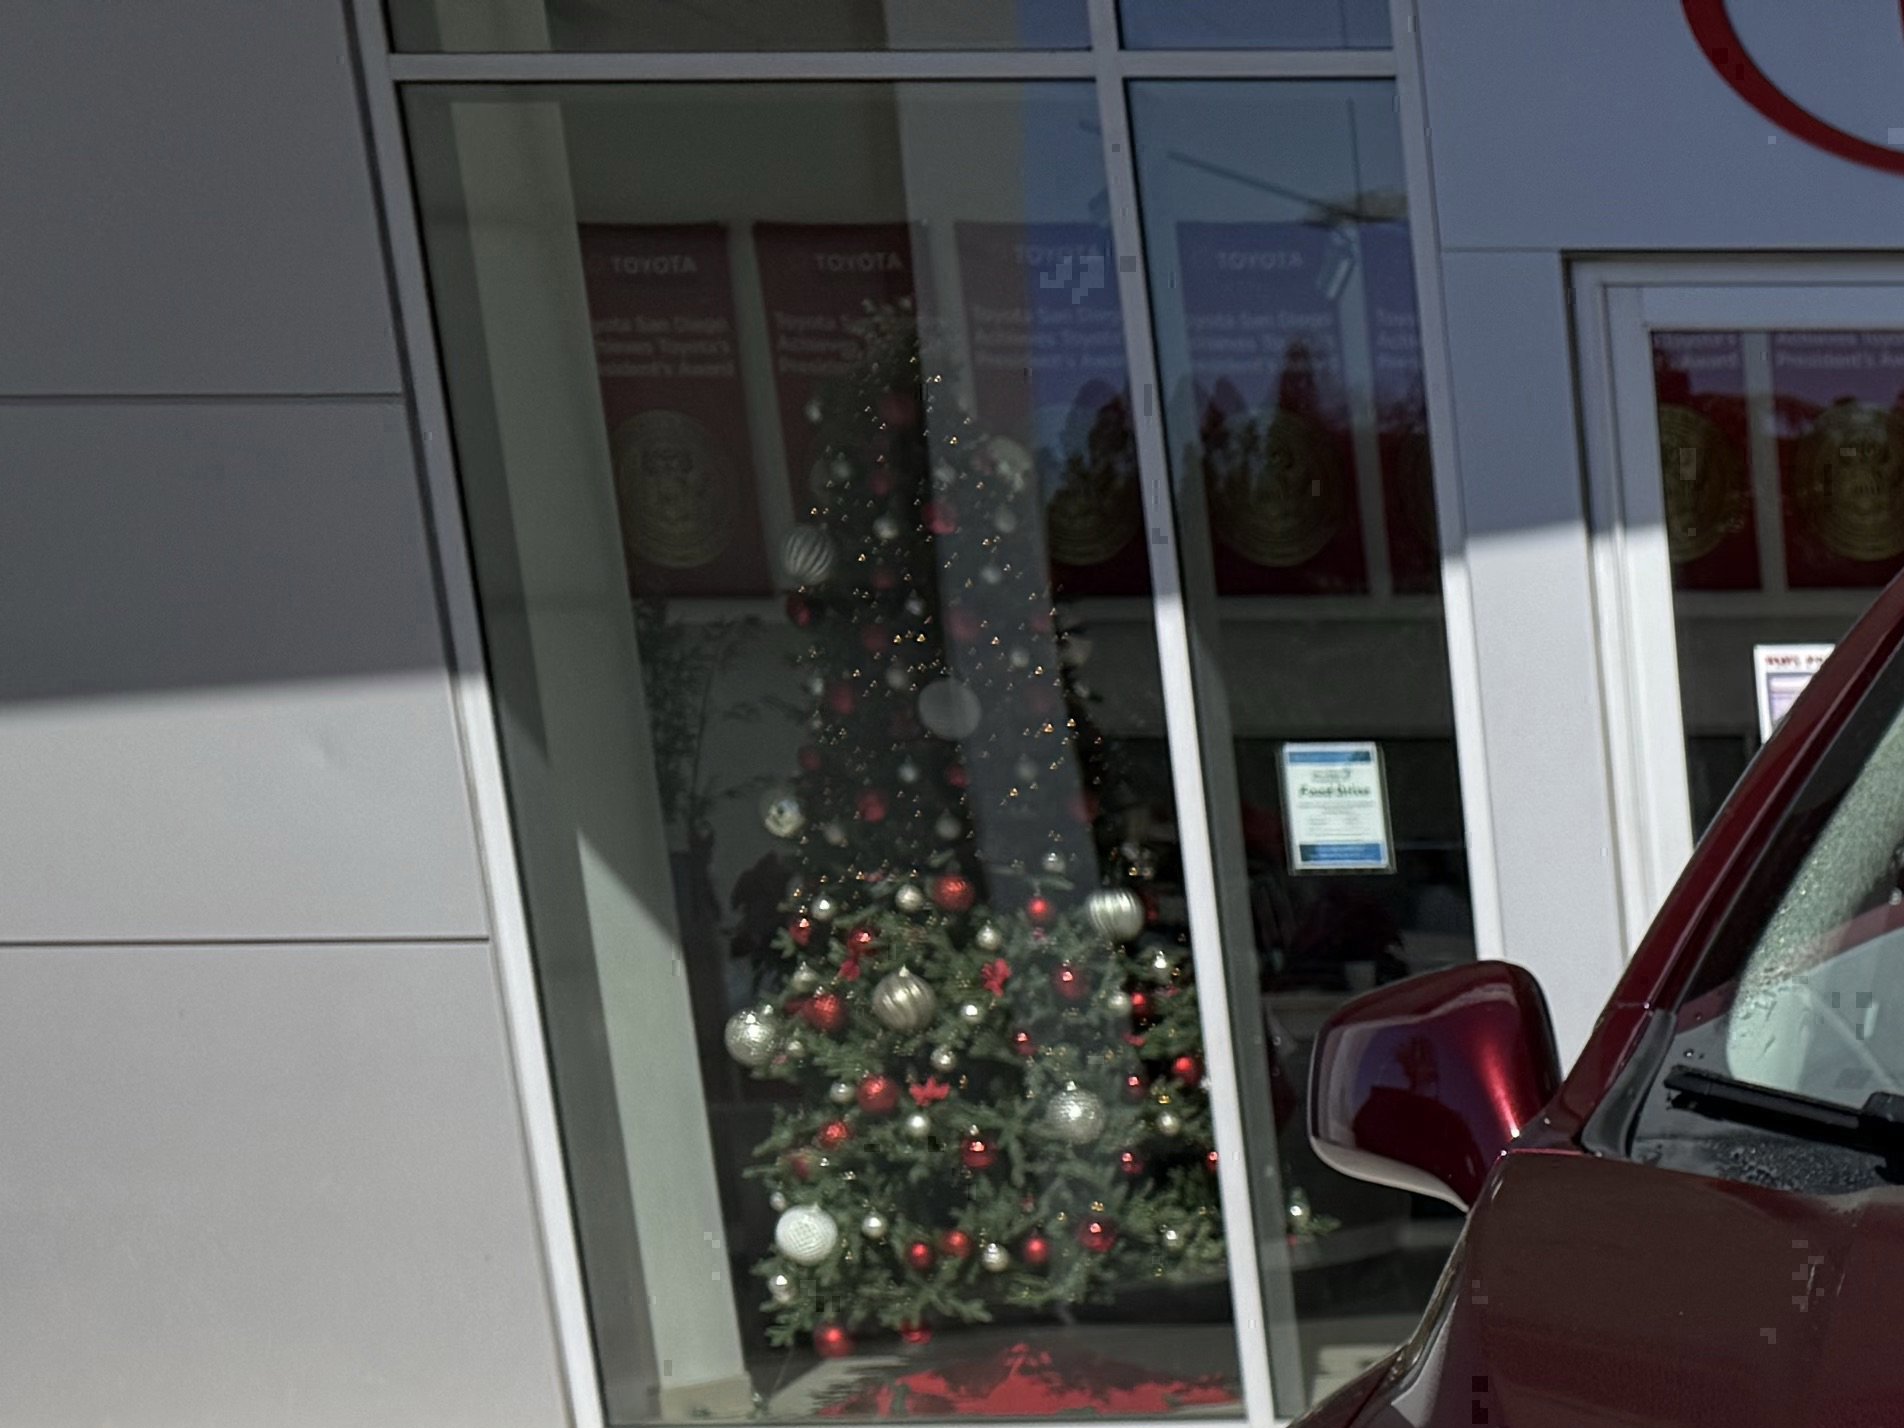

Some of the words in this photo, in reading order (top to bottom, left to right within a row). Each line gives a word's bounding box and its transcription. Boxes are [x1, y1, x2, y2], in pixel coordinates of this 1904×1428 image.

[610, 254, 699, 275] TOYOTA
[814, 252, 904, 272] TOYOTA
[1216, 251, 1304, 271] TOYOTA
